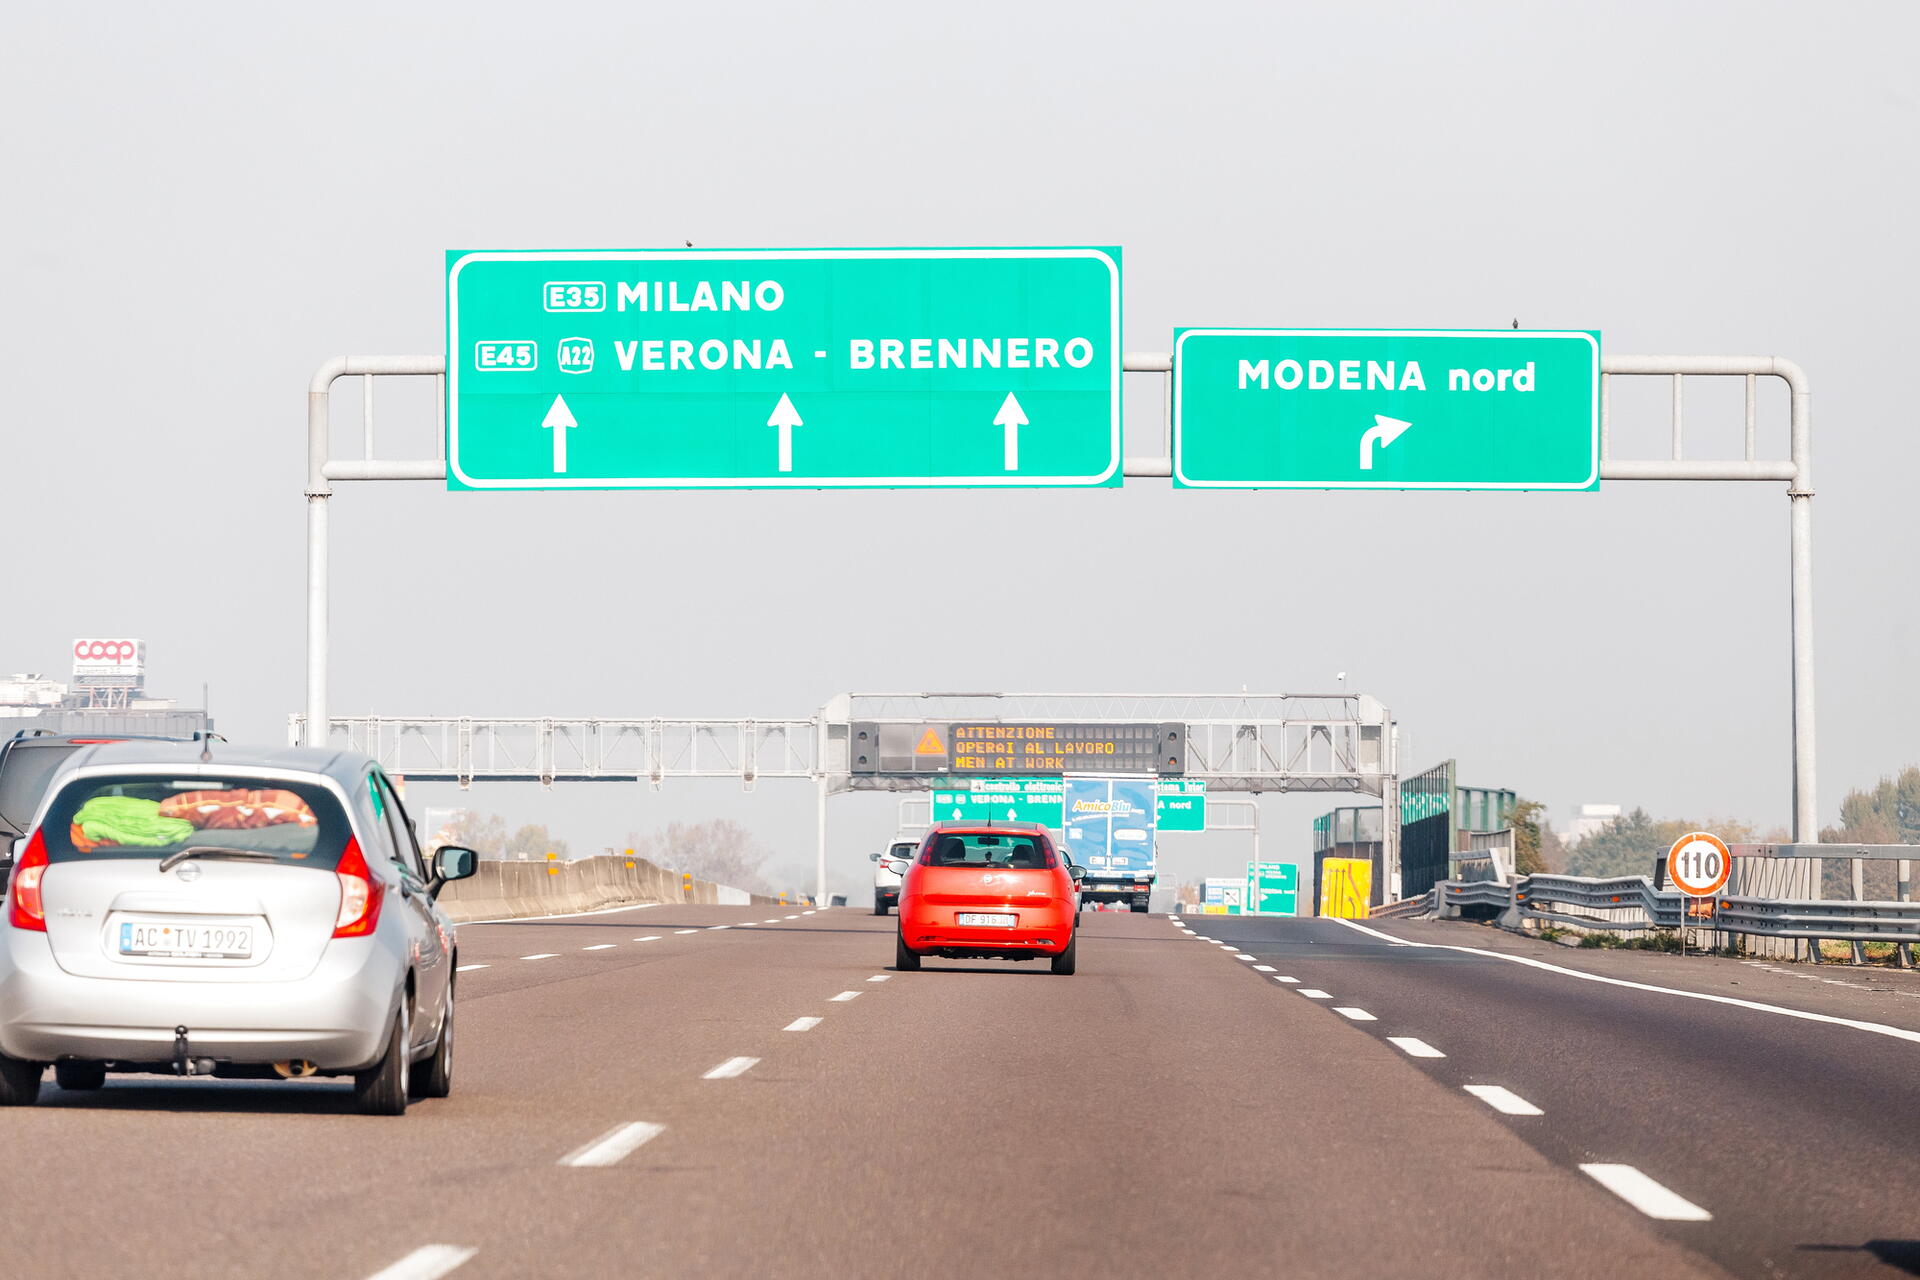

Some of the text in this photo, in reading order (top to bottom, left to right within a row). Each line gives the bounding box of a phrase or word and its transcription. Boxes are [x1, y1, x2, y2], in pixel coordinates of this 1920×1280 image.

[549, 280, 785, 312] E35 MILANO
[481, 345, 532, 366] E45
[560, 345, 593, 367] A22
[614, 339, 793, 371] VERONA
[849, 337, 1094, 369] BRENNERO
[1238, 359, 1535, 391] MODENA nord
[74, 640, 135, 664] coop
[956, 727, 1055, 739] ATTENZIONE
[956, 742, 1115, 754] OPERAI AL LAVORO
[955, 756, 1065, 768] MEN AT WORK
[971, 794, 1015, 804] VERONA
[1169, 801, 1192, 810] nord
[1681, 852, 1720, 879] 110
[135, 928, 249, 950] AC TV 1992
